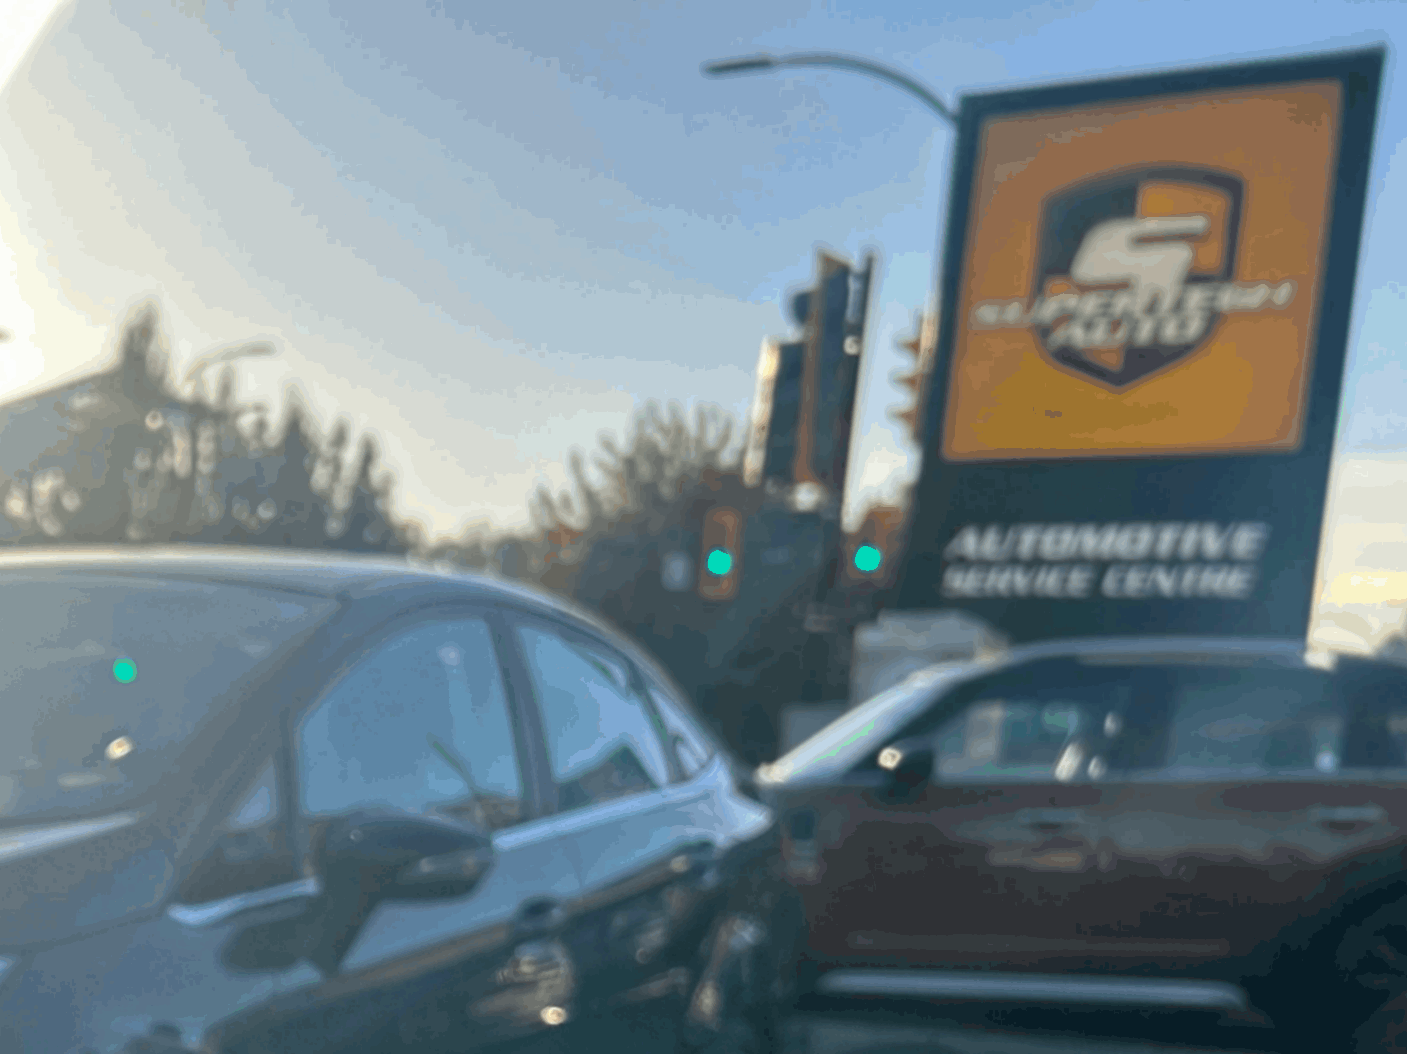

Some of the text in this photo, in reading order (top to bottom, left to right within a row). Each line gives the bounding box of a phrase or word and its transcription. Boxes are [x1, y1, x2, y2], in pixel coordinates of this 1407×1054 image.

[1049, 315, 1207, 348] AUTO
[945, 524, 1268, 561] AUTOMOTIVE
[945, 563, 1254, 597] SERVICE CENTRE
